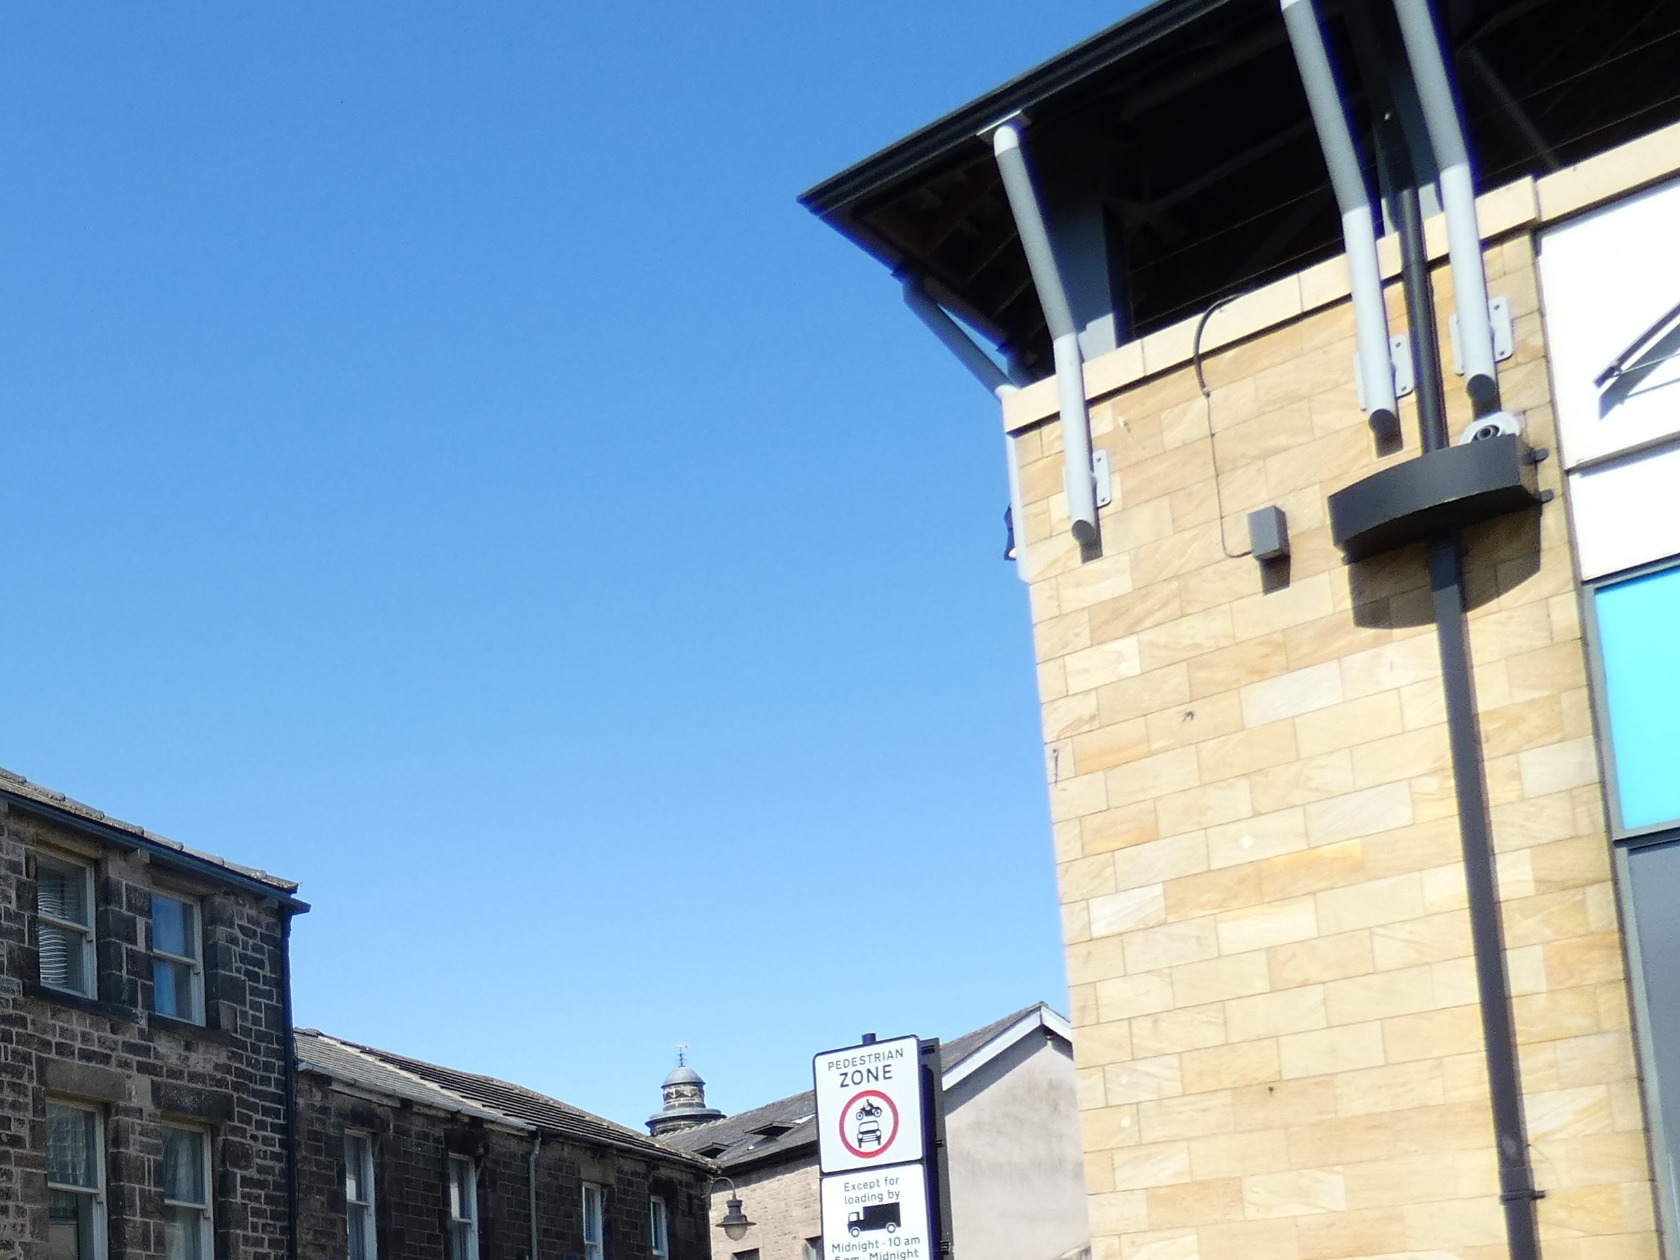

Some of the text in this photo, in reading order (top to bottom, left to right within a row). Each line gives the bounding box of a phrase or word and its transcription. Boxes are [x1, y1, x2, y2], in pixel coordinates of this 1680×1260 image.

[828, 1048, 903, 1071] PEDESTRIAN
[839, 1064, 893, 1088] ZONE
[844, 1176, 900, 1192] Except for
[844, 1190, 900, 1205] loading by
[832, 1240, 879, 1253] Midnight
[888, 1237, 901, 1247] 10
[904, 1237, 920, 1246] am
